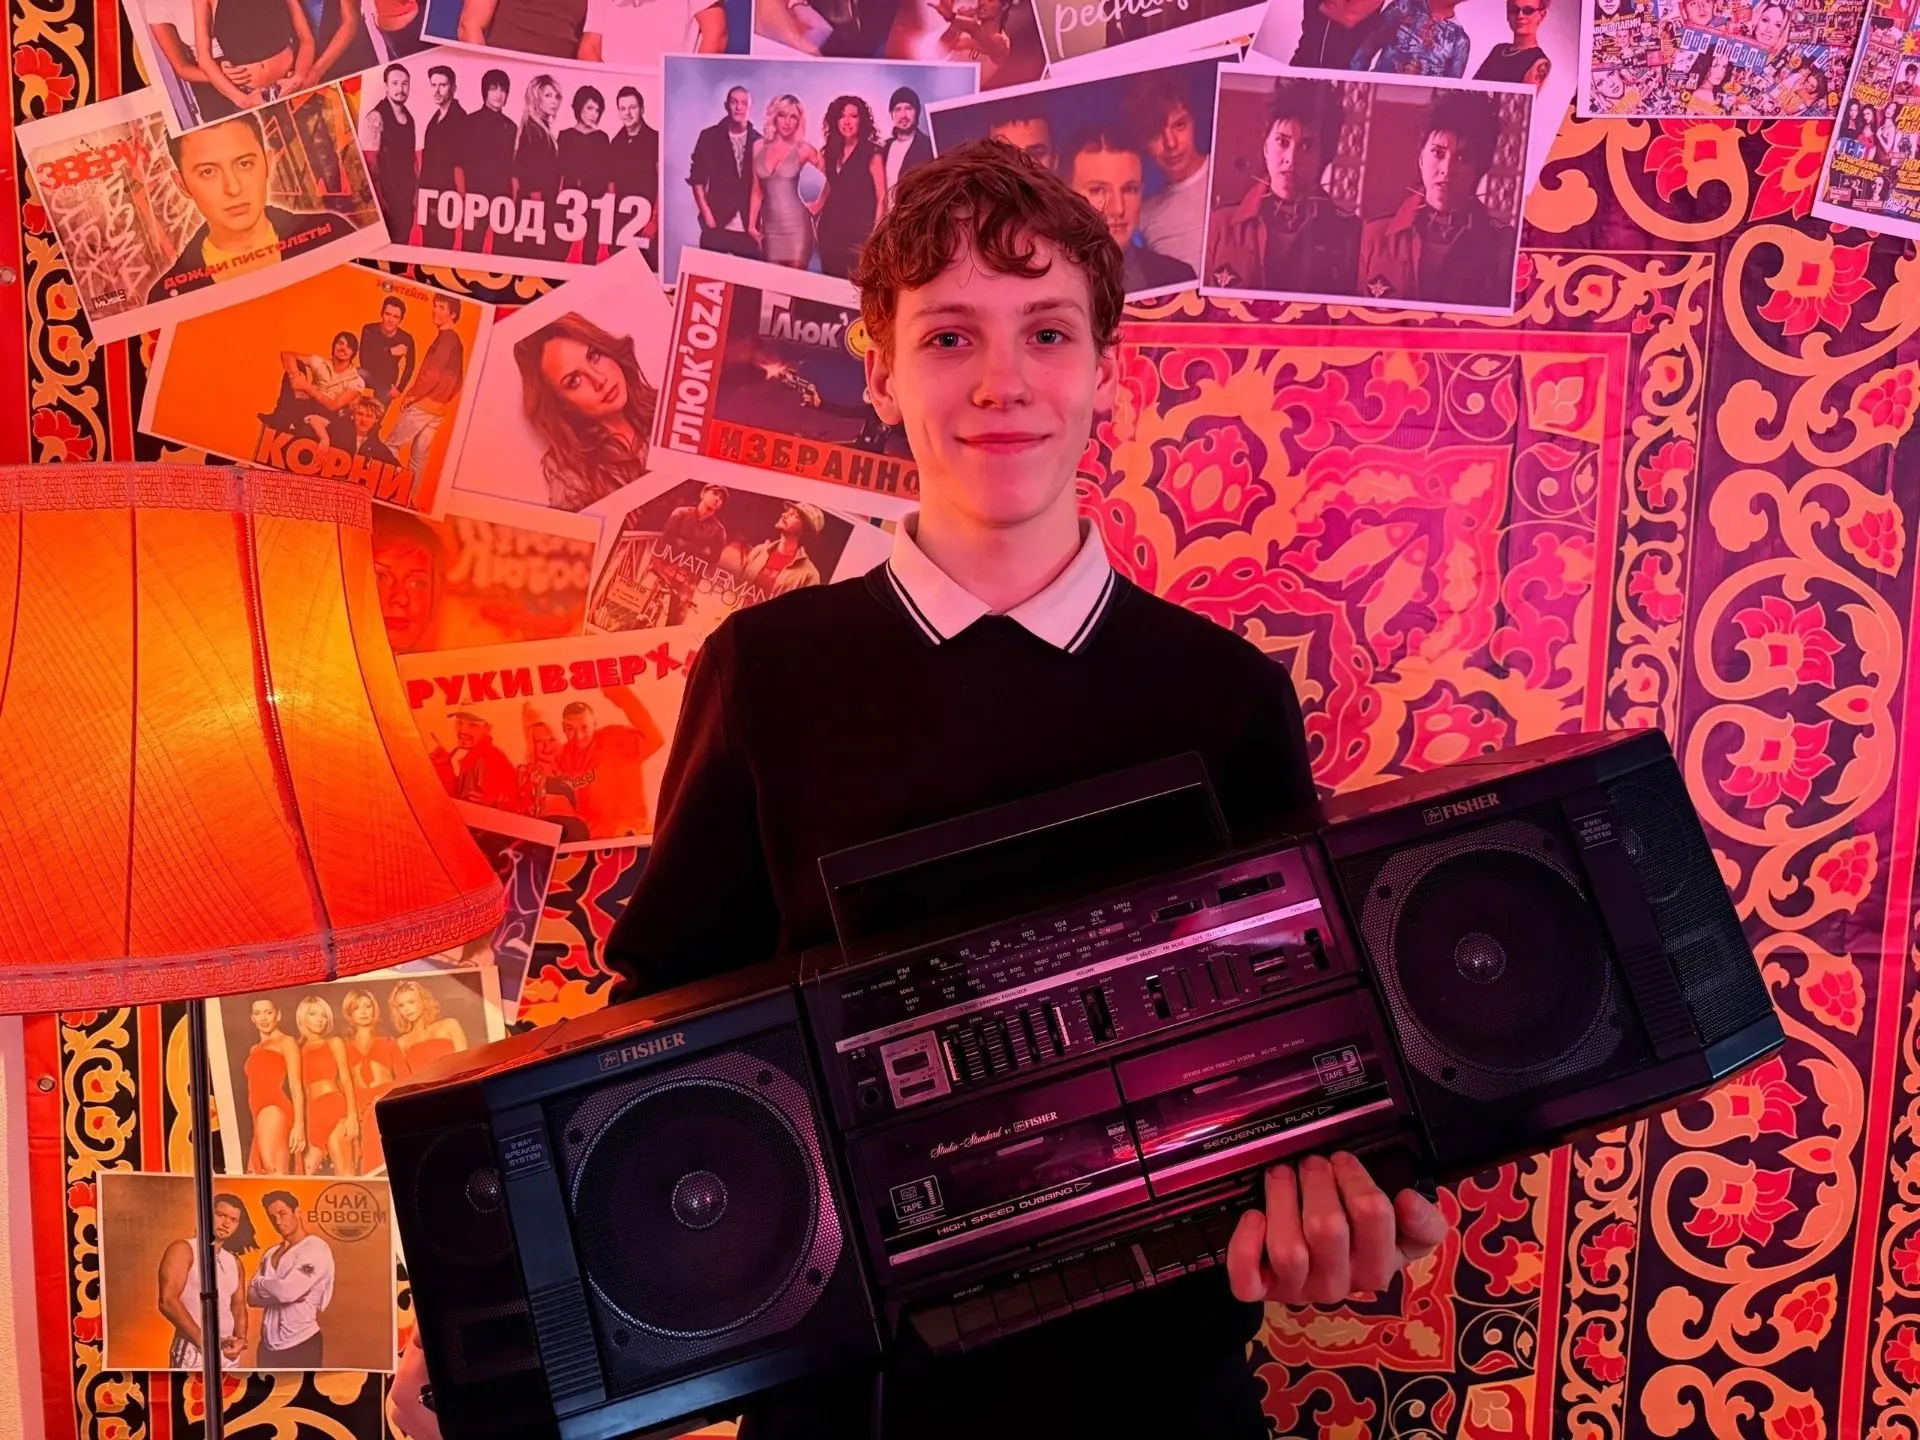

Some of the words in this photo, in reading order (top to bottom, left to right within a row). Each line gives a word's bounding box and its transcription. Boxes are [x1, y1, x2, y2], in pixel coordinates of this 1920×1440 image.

[37, 138, 151, 188] ЗВЕРИ
[416, 188, 546, 245] ГОРОД
[554, 188, 651, 250] 312
[164, 257, 230, 289] ДОЖДИ
[231, 222, 331, 269] ПИСТОЛЕТЫ
[255, 425, 415, 508] КОРНИ
[406, 667, 534, 710] РУКИ
[1442, 792, 1500, 819] FISHER
[620, 1032, 686, 1062] FISHER
[1324, 1069, 1345, 1081] TAPE
[1024, 1111, 1058, 1128] FISHER
[1202, 1121, 1281, 1150] SEQUENTIAL
[1285, 1109, 1315, 1125] PLAY
[505, 1143, 542, 1160] SPEAKER
[509, 1151, 541, 1167] SYSTEM
[325, 1192, 367, 1209] ЧАЙ
[901, 1200, 924, 1214] TAPE
[936, 1221, 967, 1236] HIGH
[971, 1205, 1015, 1224] SPEED
[1019, 1187, 1073, 1209] DUBBING
